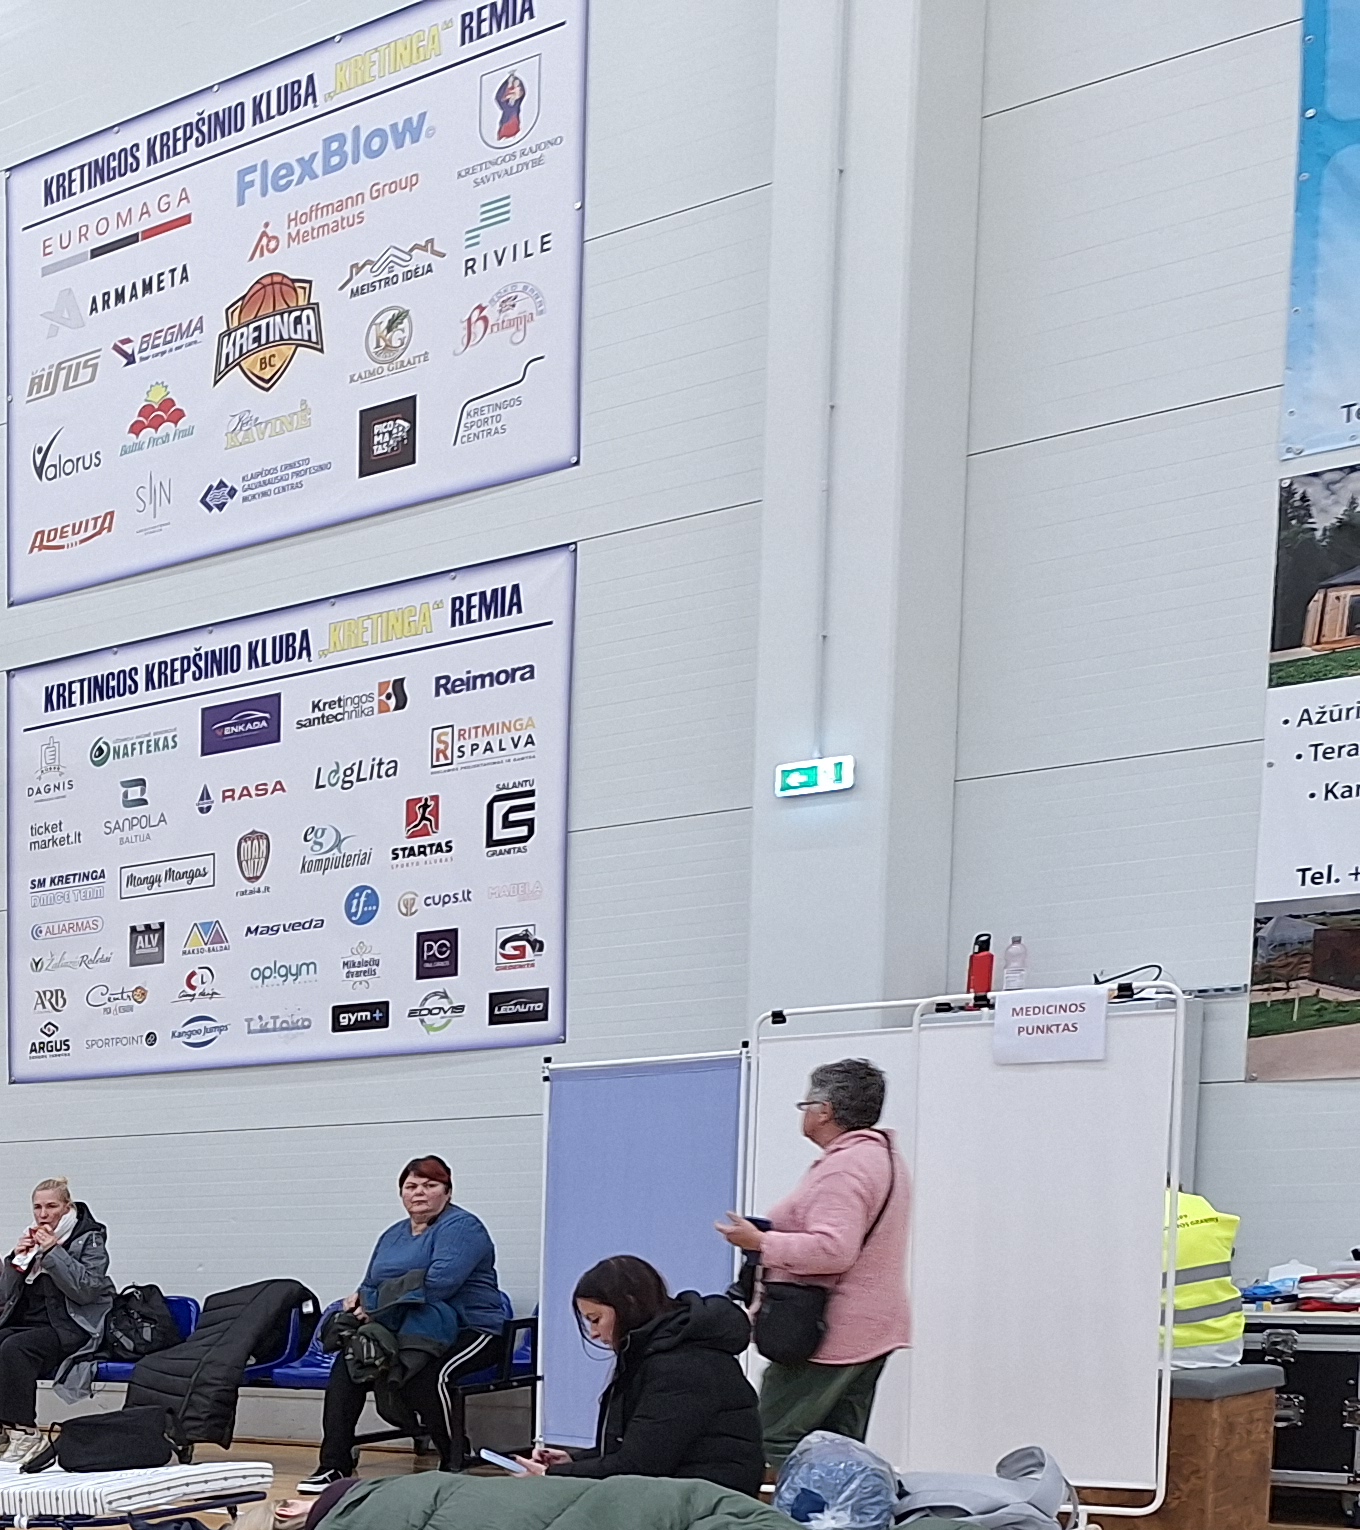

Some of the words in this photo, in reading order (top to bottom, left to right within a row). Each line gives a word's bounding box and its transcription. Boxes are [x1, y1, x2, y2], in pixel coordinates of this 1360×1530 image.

[43, 142, 141, 208] KRETINGOS
[146, 101, 246, 168] KREPŠINIO
[251, 72, 318, 128] KLUBĄ
[460, 0, 536, 47] REMIA
[457, 152, 517, 180] KRETINGOS
[287, 191, 365, 230] Hoffmann
[369, 173, 419, 202] Group
[42, 187, 191, 257] EUROMAGA
[287, 211, 365, 248] Metmatus
[464, 232, 552, 278] RIVILE
[89, 263, 190, 316] ARMAMETA
[349, 274, 399, 299] MEISTRO
[401, 262, 434, 283] IDĖJA
[137, 315, 204, 354] BEGMA
[221, 308, 318, 372] KRETINGA
[259, 353, 277, 372] BC
[349, 364, 385, 384] KAIMO
[466, 396, 523, 419] KRETINGOS
[463, 412, 503, 432] SPORTO
[460, 424, 507, 446] CENTRAS
[43, 666, 139, 713] KRETINGOS
[144, 644, 242, 692] KREPŠINIO
[247, 628, 312, 672] KLUBĄ
[450, 583, 523, 628] REMIA
[433, 663, 535, 698] Reimora
[311, 691, 375, 714] Kretingos
[295, 705, 375, 730] santechnika
[457, 715, 536, 742] RITMINGA
[112, 734, 178, 761] NAFTEKAS
[456, 733, 536, 759] SPALVA
[27, 780, 74, 798] DAGNIS
[221, 780, 287, 803] RASA
[30, 819, 64, 837] ticket
[103, 812, 168, 836] SANPOLA
[29, 831, 82, 852] market.lt
[391, 839, 454, 861] STARTAS
[486, 845, 528, 858] GRANITAS
[300, 848, 373, 875] kompiuteriai
[30, 878, 46, 890] SM
[49, 869, 106, 887] KRETINGA
[1295, 864, 1341, 887] Tel.
[423, 888, 473, 907] cups.lt
[44, 919, 99, 937] ALIARMAS
[245, 917, 325, 937] Magveda
[135, 933, 159, 949] ALV
[33, 989, 67, 1012] ARB
[1011, 1002, 1086, 1018] MEDICINOS
[171, 1028, 202, 1040] Kangoo
[202, 1023, 230, 1036] Jumps
[1017, 1021, 1079, 1036] PUNKTAS
[29, 1038, 71, 1055] ARGUS
[85, 1034, 145, 1050] SPORTPOINT
